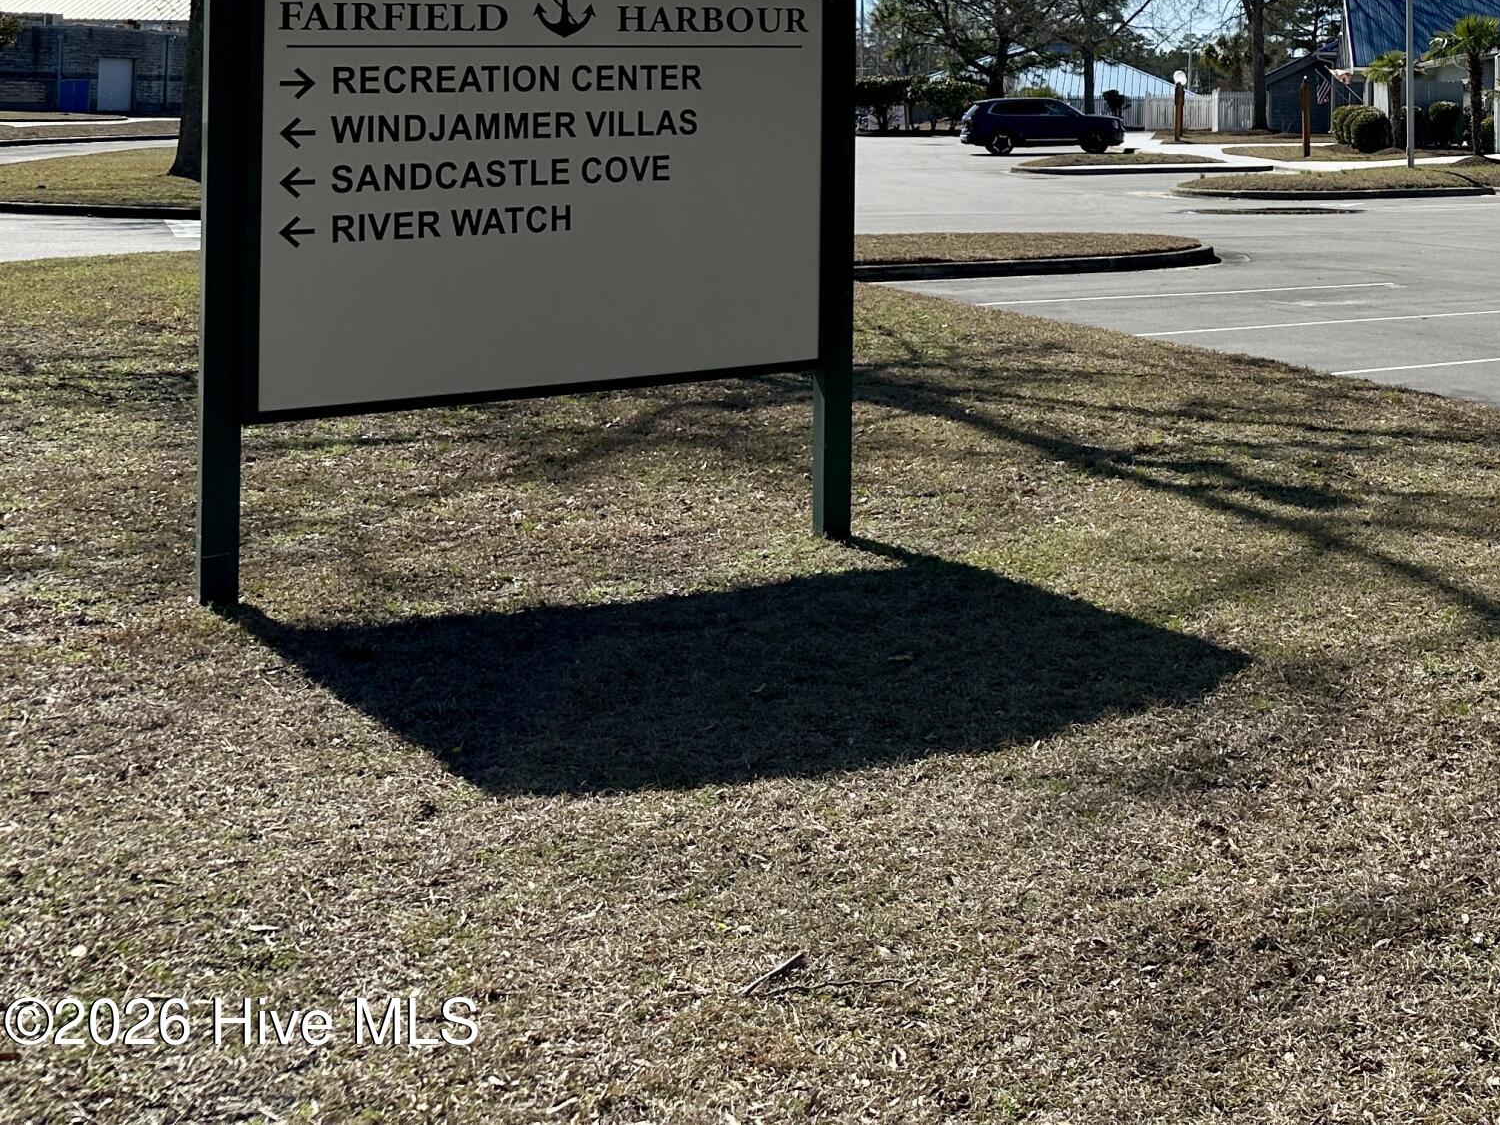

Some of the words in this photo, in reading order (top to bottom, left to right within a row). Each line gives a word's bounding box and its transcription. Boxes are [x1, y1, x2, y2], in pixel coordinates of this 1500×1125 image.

[278, 2, 508, 31] FAIRFIELD
[617, 6, 809, 33] HARBOUR
[333, 65, 559, 94] RECREATION
[572, 65, 702, 91] CENTER
[331, 112, 576, 143] WINDJAMMER
[585, 109, 697, 137] VILLAS
[332, 158, 569, 193] SANDCASTLE
[582, 155, 670, 184] COVE
[332, 211, 441, 243] RIVER
[451, 205, 570, 236] WATCH
